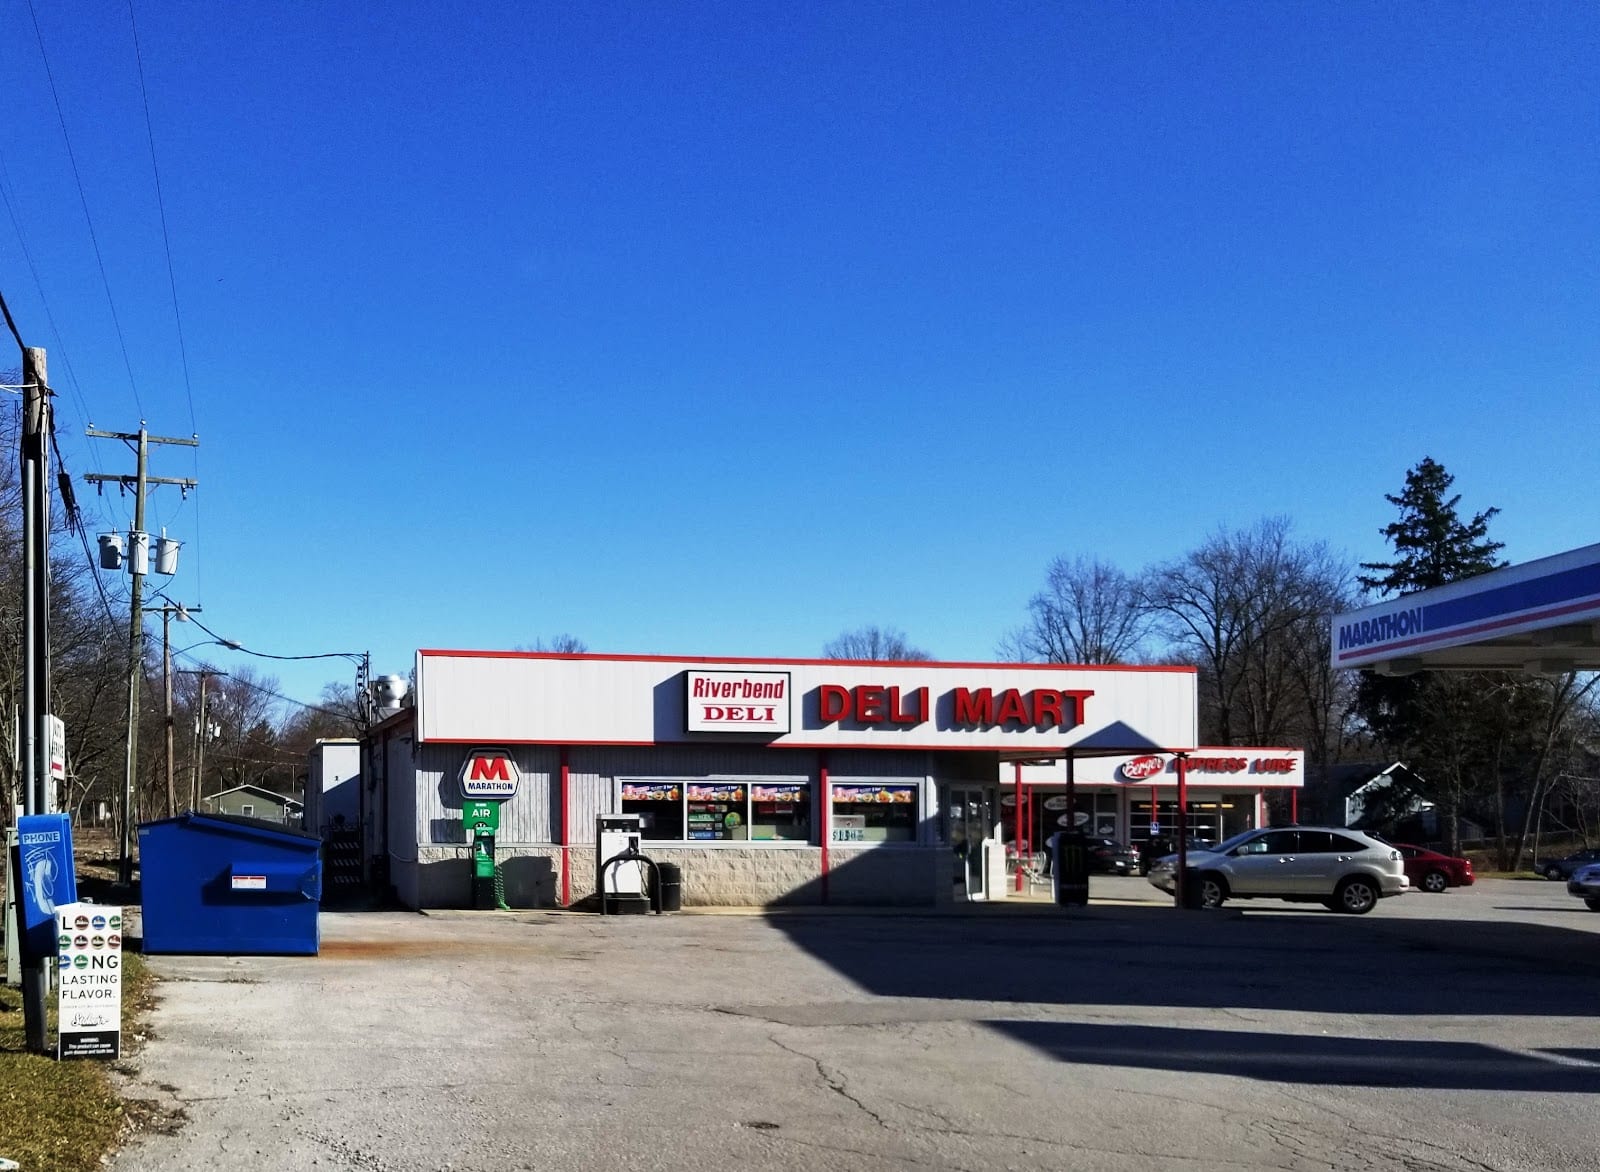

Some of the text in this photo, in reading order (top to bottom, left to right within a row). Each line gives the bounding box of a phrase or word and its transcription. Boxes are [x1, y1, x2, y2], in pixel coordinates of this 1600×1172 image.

[1339, 608, 1421, 650] MARATHON
[693, 678, 784, 699] Riverbend
[819, 685, 1095, 725] DELI MART
[704, 707, 774, 721] DELI
[470, 756, 510, 780] M
[1255, 758, 1297, 771] LUBE
[472, 809, 490, 818] AIR
[23, 832, 60, 843] PHONE
[62, 975, 118, 985] LASTING
[62, 990, 116, 999] FLAVOR.
